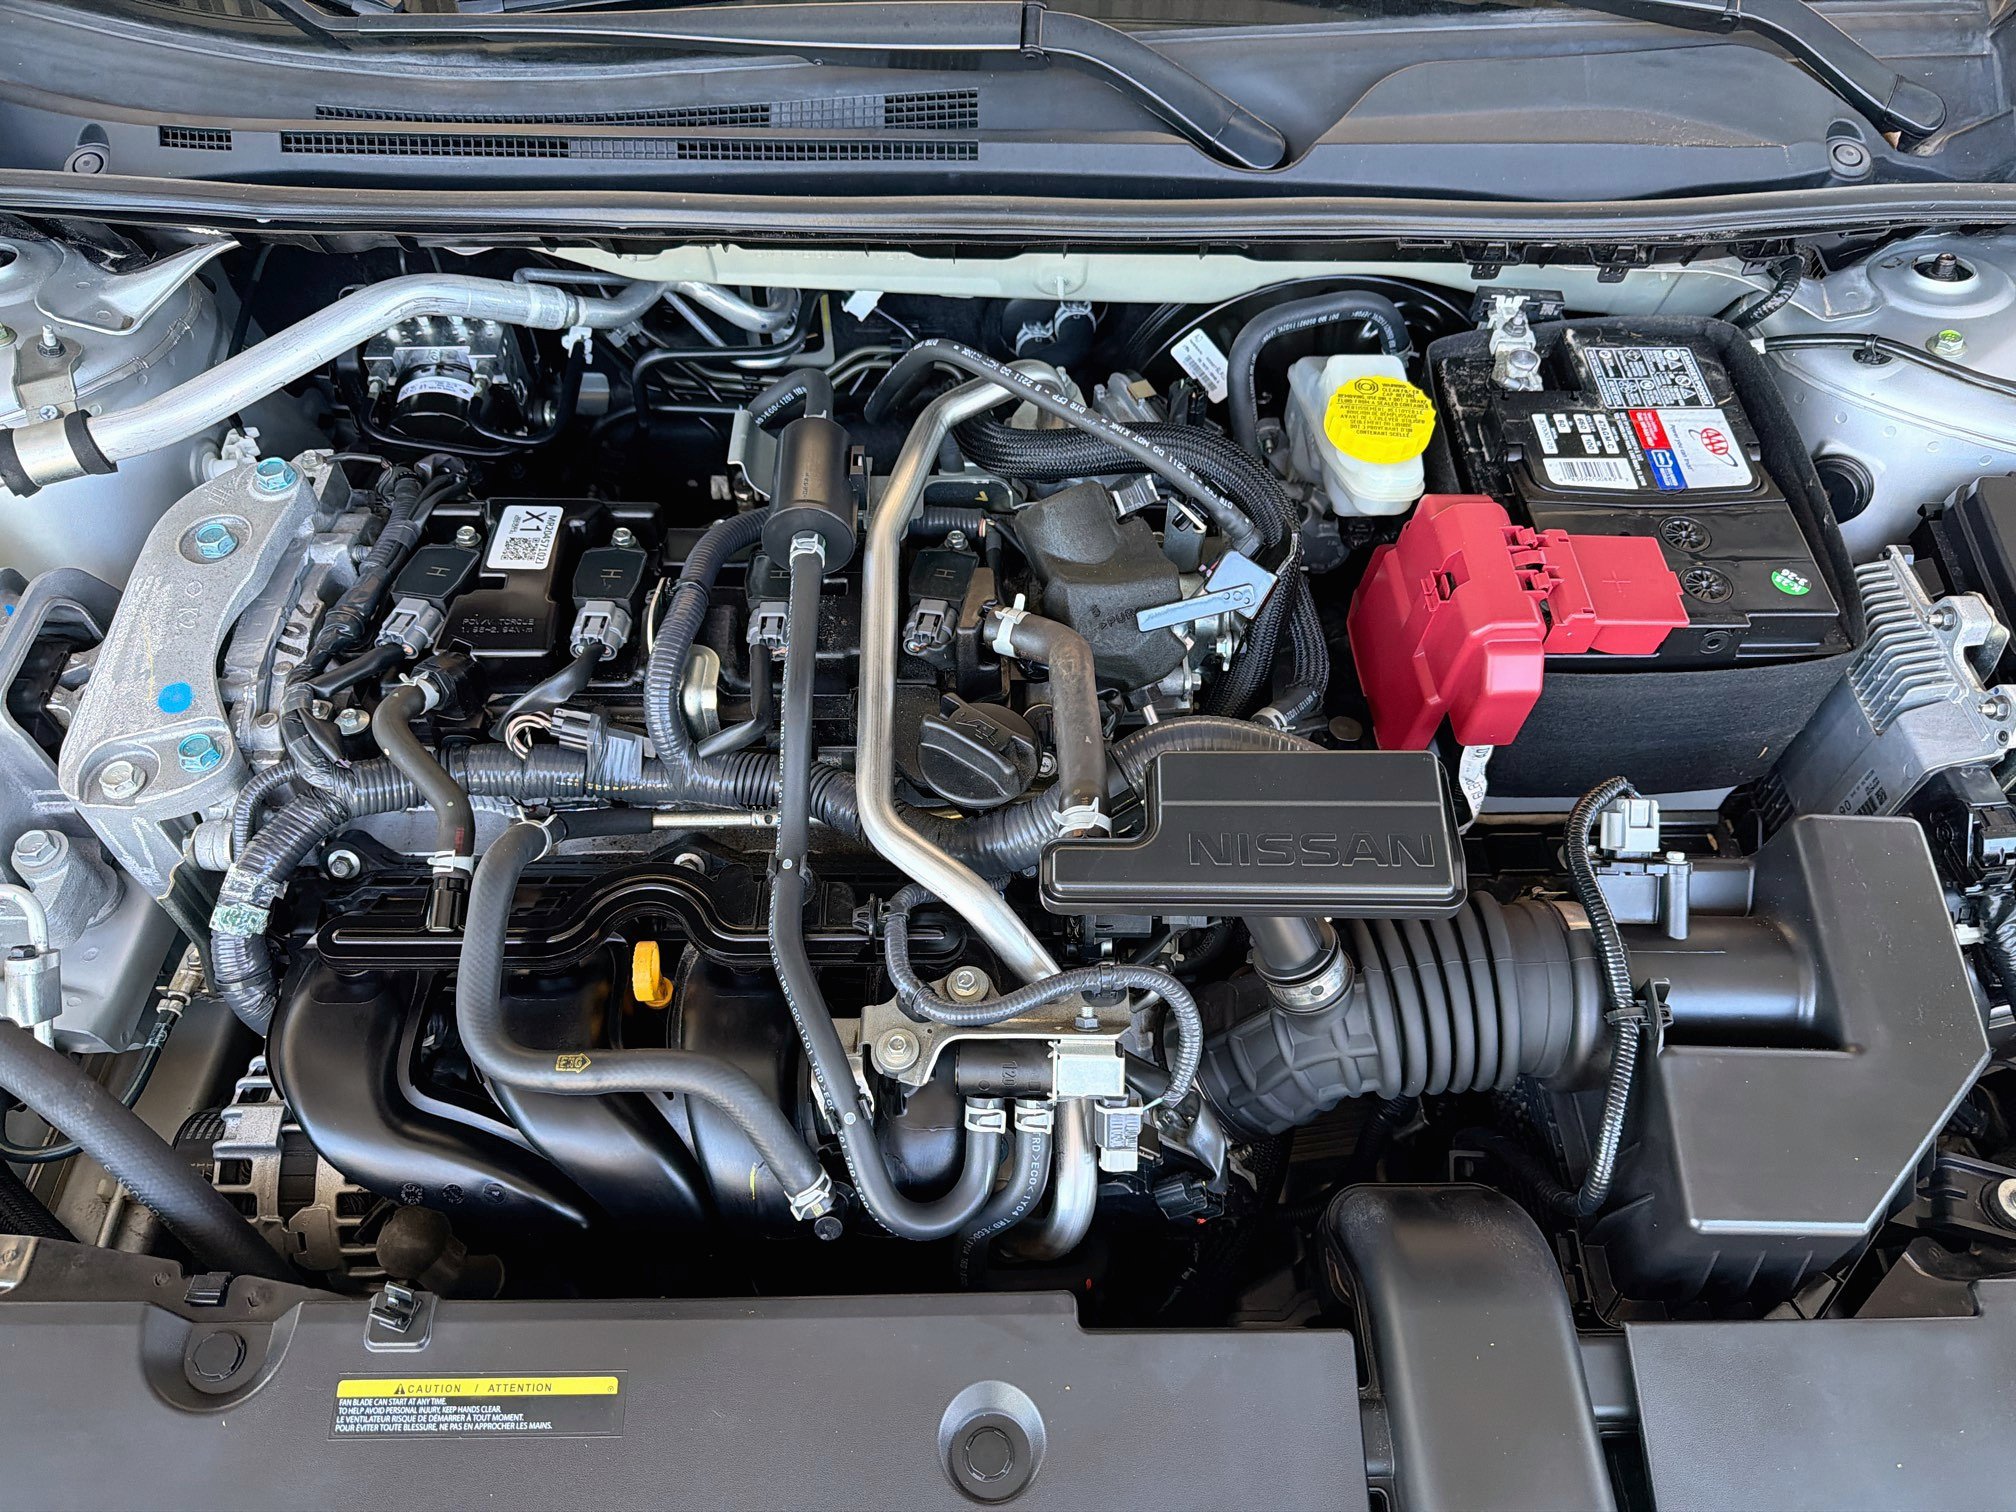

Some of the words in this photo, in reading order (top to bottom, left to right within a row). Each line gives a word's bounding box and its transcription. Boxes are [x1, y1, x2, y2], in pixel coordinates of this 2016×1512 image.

[1013, 372, 1034, 387] 2211
[1051, 394, 1068, 405] CFP
[1069, 401, 1087, 414] DTR
[1108, 422, 1131, 437] KINK
[1132, 436, 1151, 448] NOT
[1585, 438, 1595, 450] 100
[1700, 427, 1730, 456] AAA
[1168, 456, 1186, 473] 2211
[520, 510, 548, 532] X1
[1188, 832, 1436, 868] NISSAN
[1001, 1060, 1018, 1087] 120
[407, 1383, 462, 1394] CAUTION
[487, 1383, 553, 1393] ATTENTION
[339, 1398, 352, 1406] FAN
[352, 1398, 373, 1406] BLADE
[373, 1398, 388, 1406] CAN
[431, 1397, 447, 1405] TIME.
[338, 1406, 348, 1415] TO
[348, 1406, 365, 1415] HELP
[365, 1406, 385, 1414] AVOID
[385, 1406, 418, 1414] PERSONAL
[457, 1405, 480, 1413] HANDS
[480, 1405, 502, 1413] CLEAR.
[336, 1415, 345, 1423] LE
[345, 1415, 391, 1423] VENTILATEUR
[391, 1414, 417, 1423] RISQUE
[417, 1414, 427, 1422] DE
[428, 1412, 465, 1422] DÉMARRER
[466, 1412, 472, 1421] À
[472, 1413, 492, 1421] TOUT
[491, 1413, 525, 1421] MOMENT.
[335, 1424, 355, 1432] POUR
[355, 1422, 380, 1432] ÉVITER
[379, 1423, 402, 1432] TOUTE
[438, 1423, 449, 1431] NE
[449, 1422, 462, 1430] PAS
[463, 1422, 474, 1430] EN
[473, 1422, 516, 1430] APPROCHER
[528, 1421, 553, 1429] MAINS.
